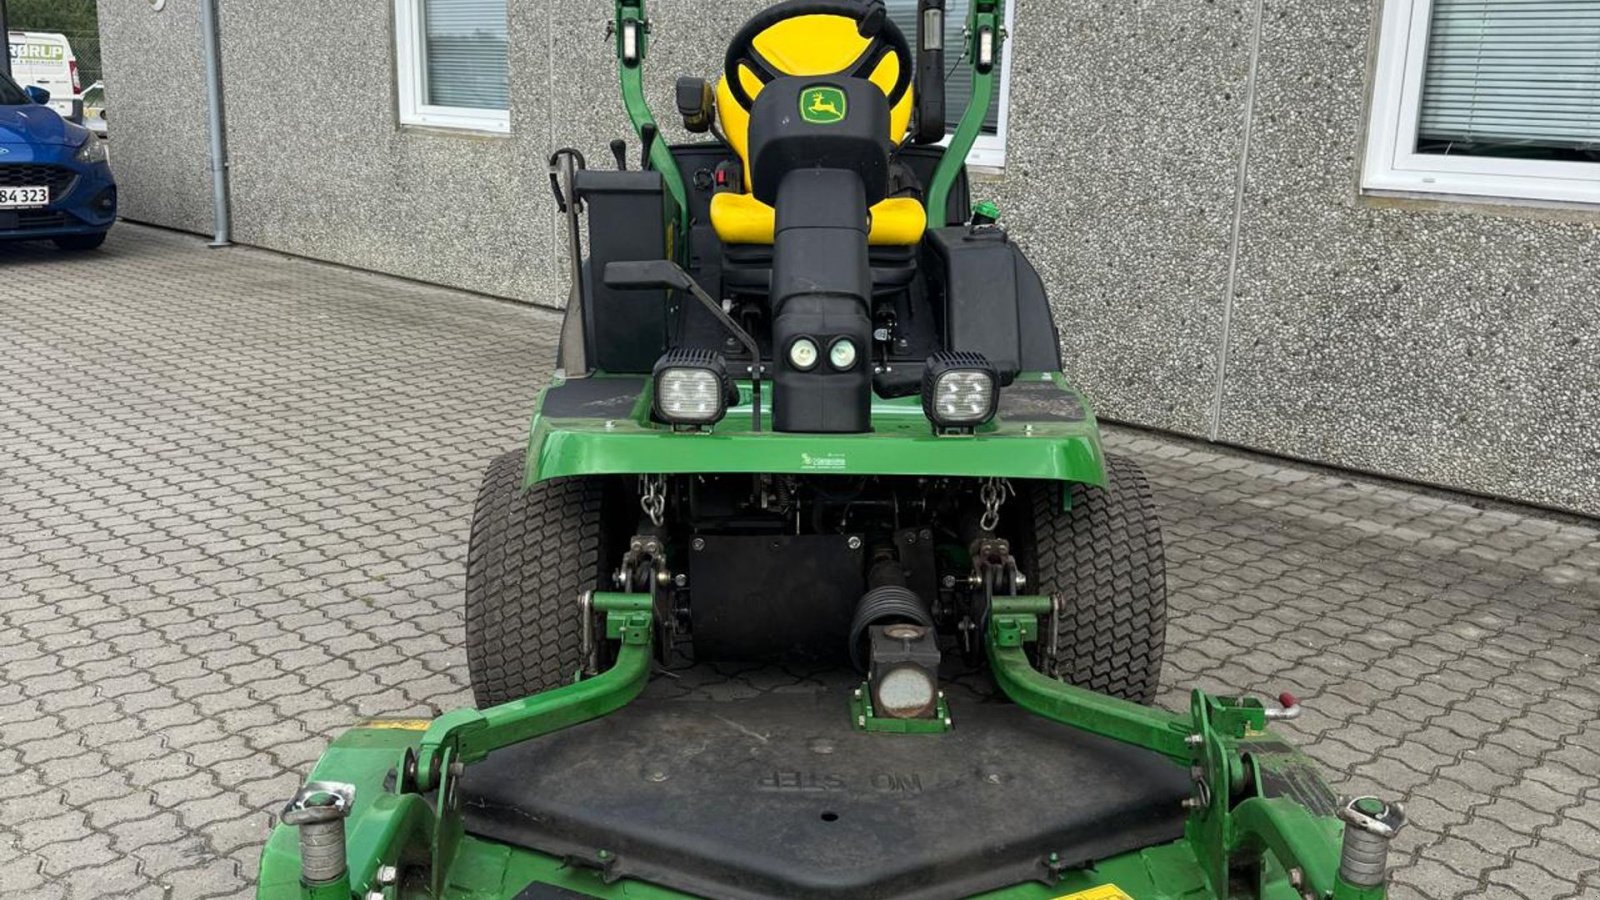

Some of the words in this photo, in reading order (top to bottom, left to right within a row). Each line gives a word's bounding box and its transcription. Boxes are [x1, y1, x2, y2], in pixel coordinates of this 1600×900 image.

[21, 189, 47, 202] 323
[758, 770, 847, 793] STEP
[870, 773, 924, 793] NO
